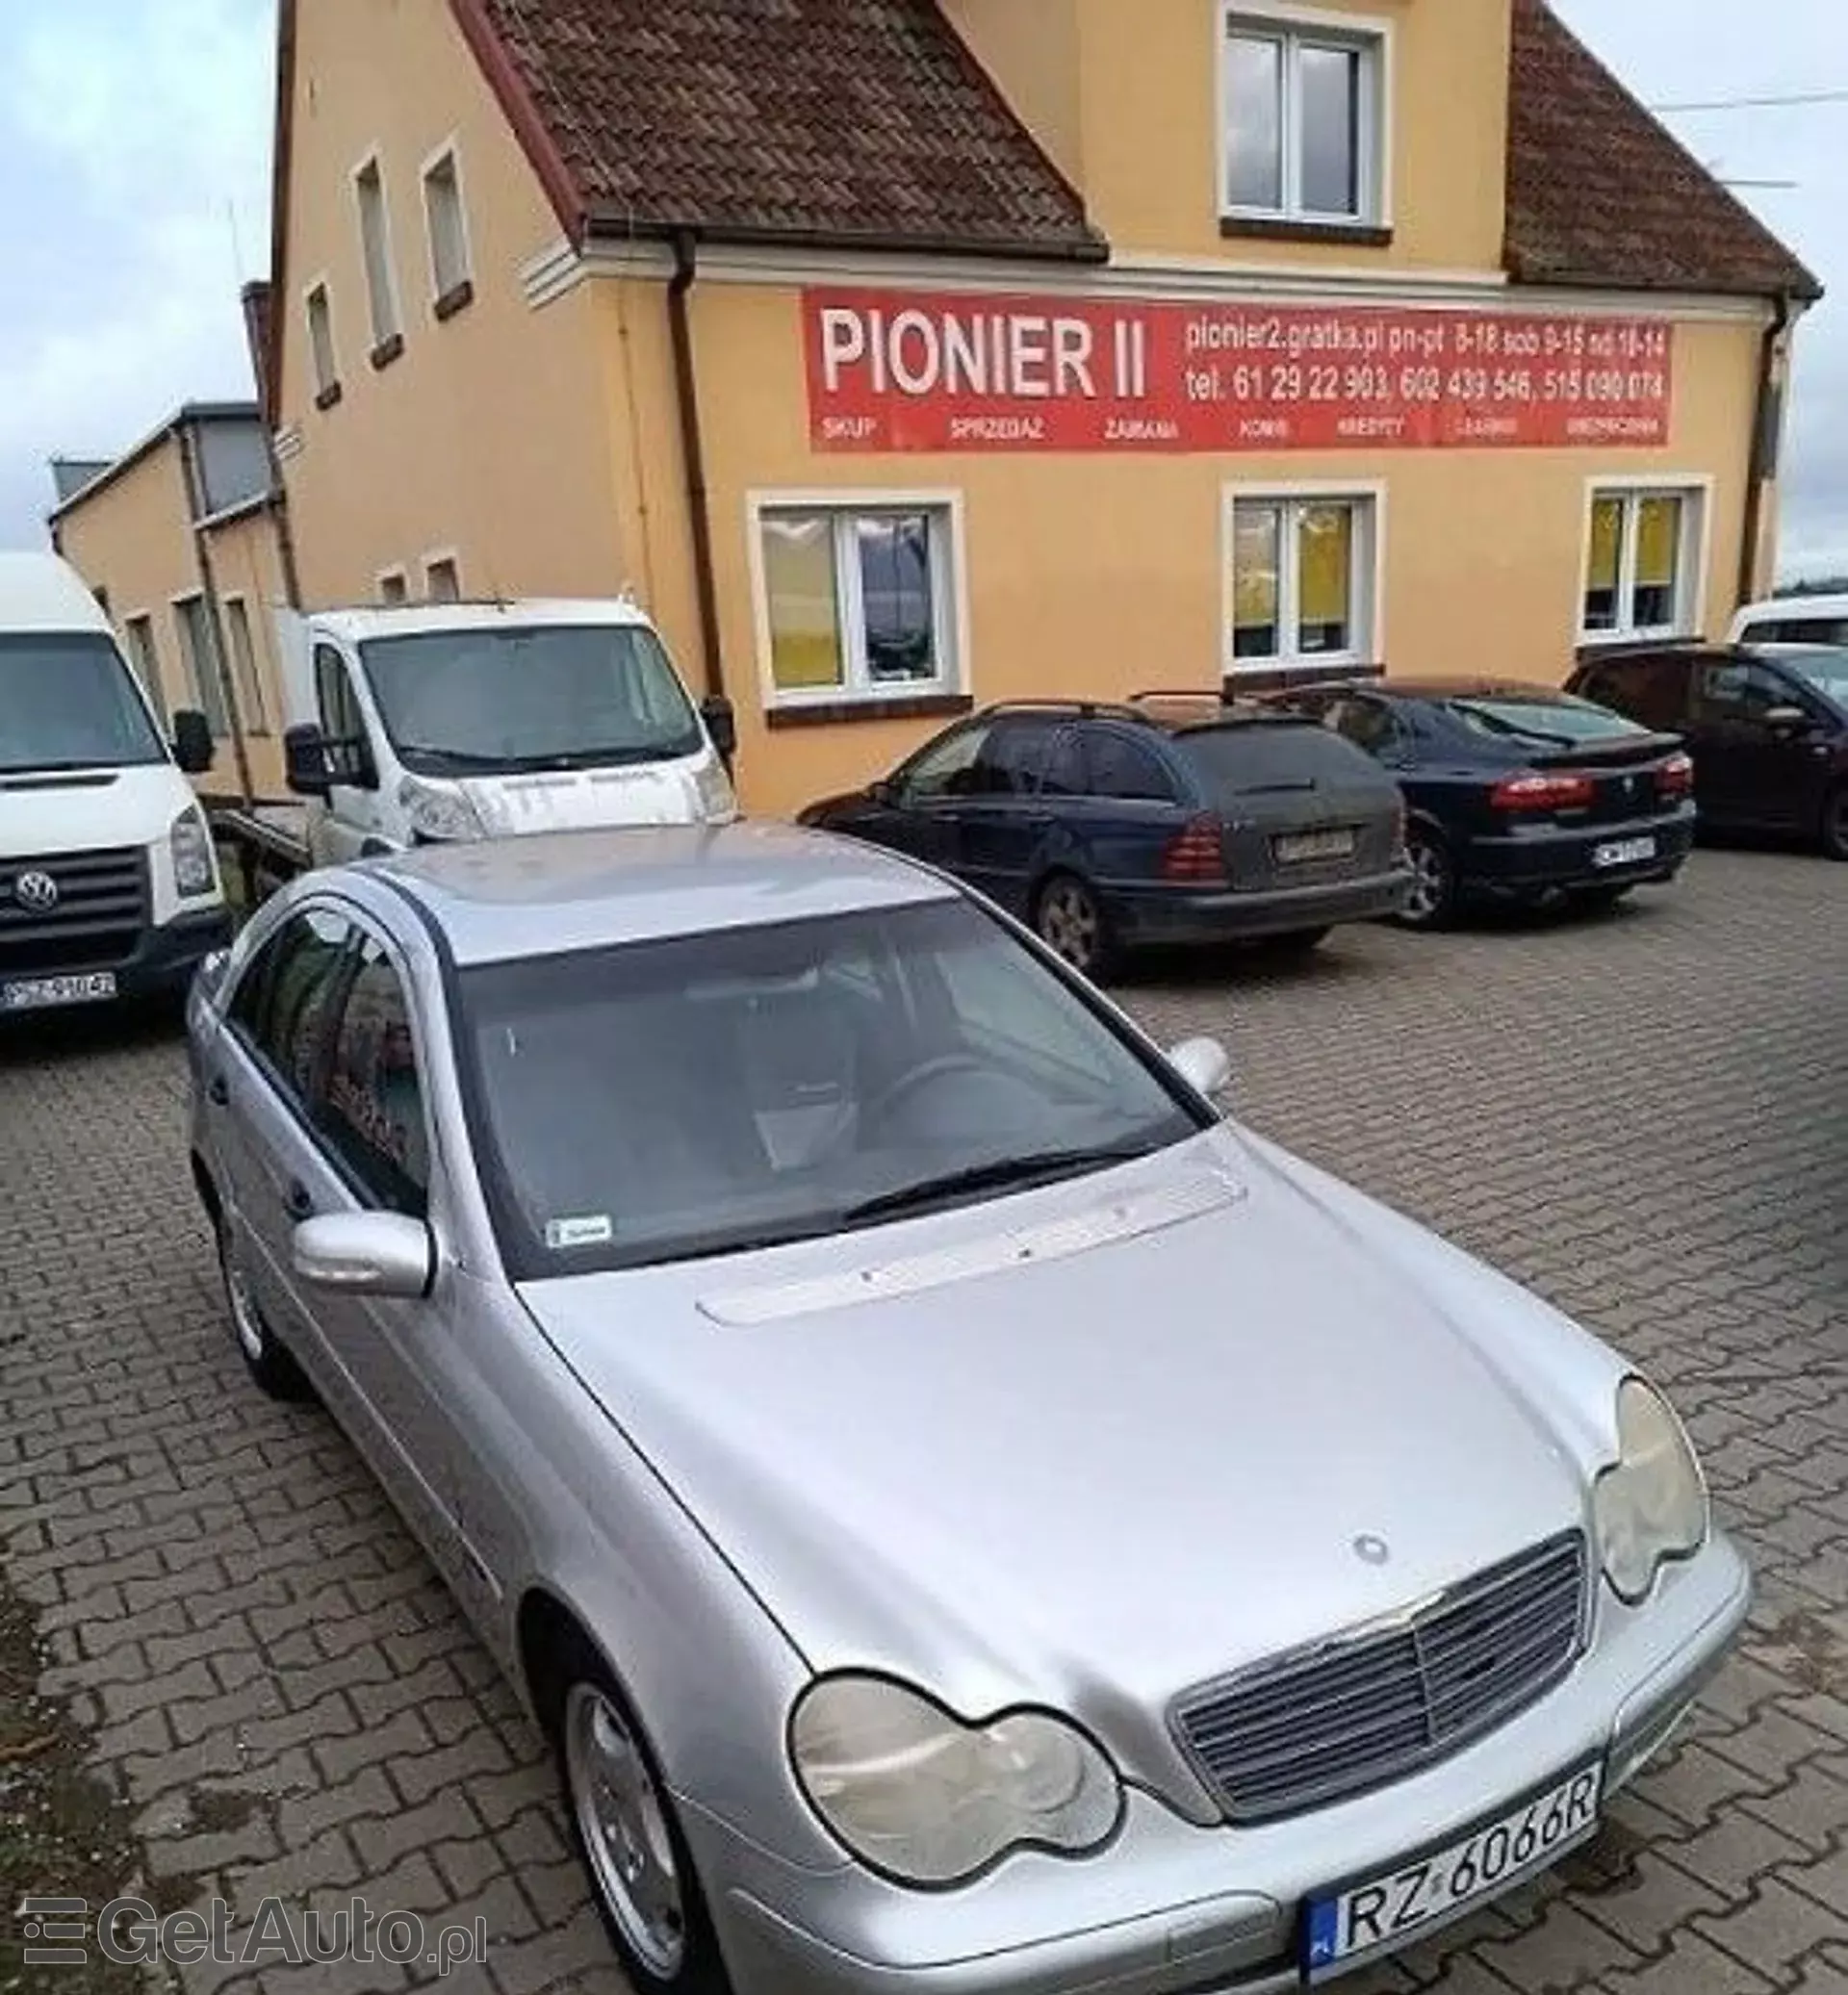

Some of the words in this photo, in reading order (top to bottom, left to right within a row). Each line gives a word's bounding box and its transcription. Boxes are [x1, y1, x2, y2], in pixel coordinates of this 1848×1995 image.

[820, 307, 1097, 398] PIONIER
[1114, 320, 1146, 397] II
[1186, 314, 1384, 359] pionier2.gratka.pl
[1186, 364, 1226, 400] tel.
[1233, 365, 1263, 400] 61
[1270, 365, 1300, 400] 29
[1309, 365, 1340, 400] 22
[821, 416, 877, 439] SKUP
[1347, 1860, 1432, 1948] RZ
[1448, 1773, 1594, 1900] 6066R
